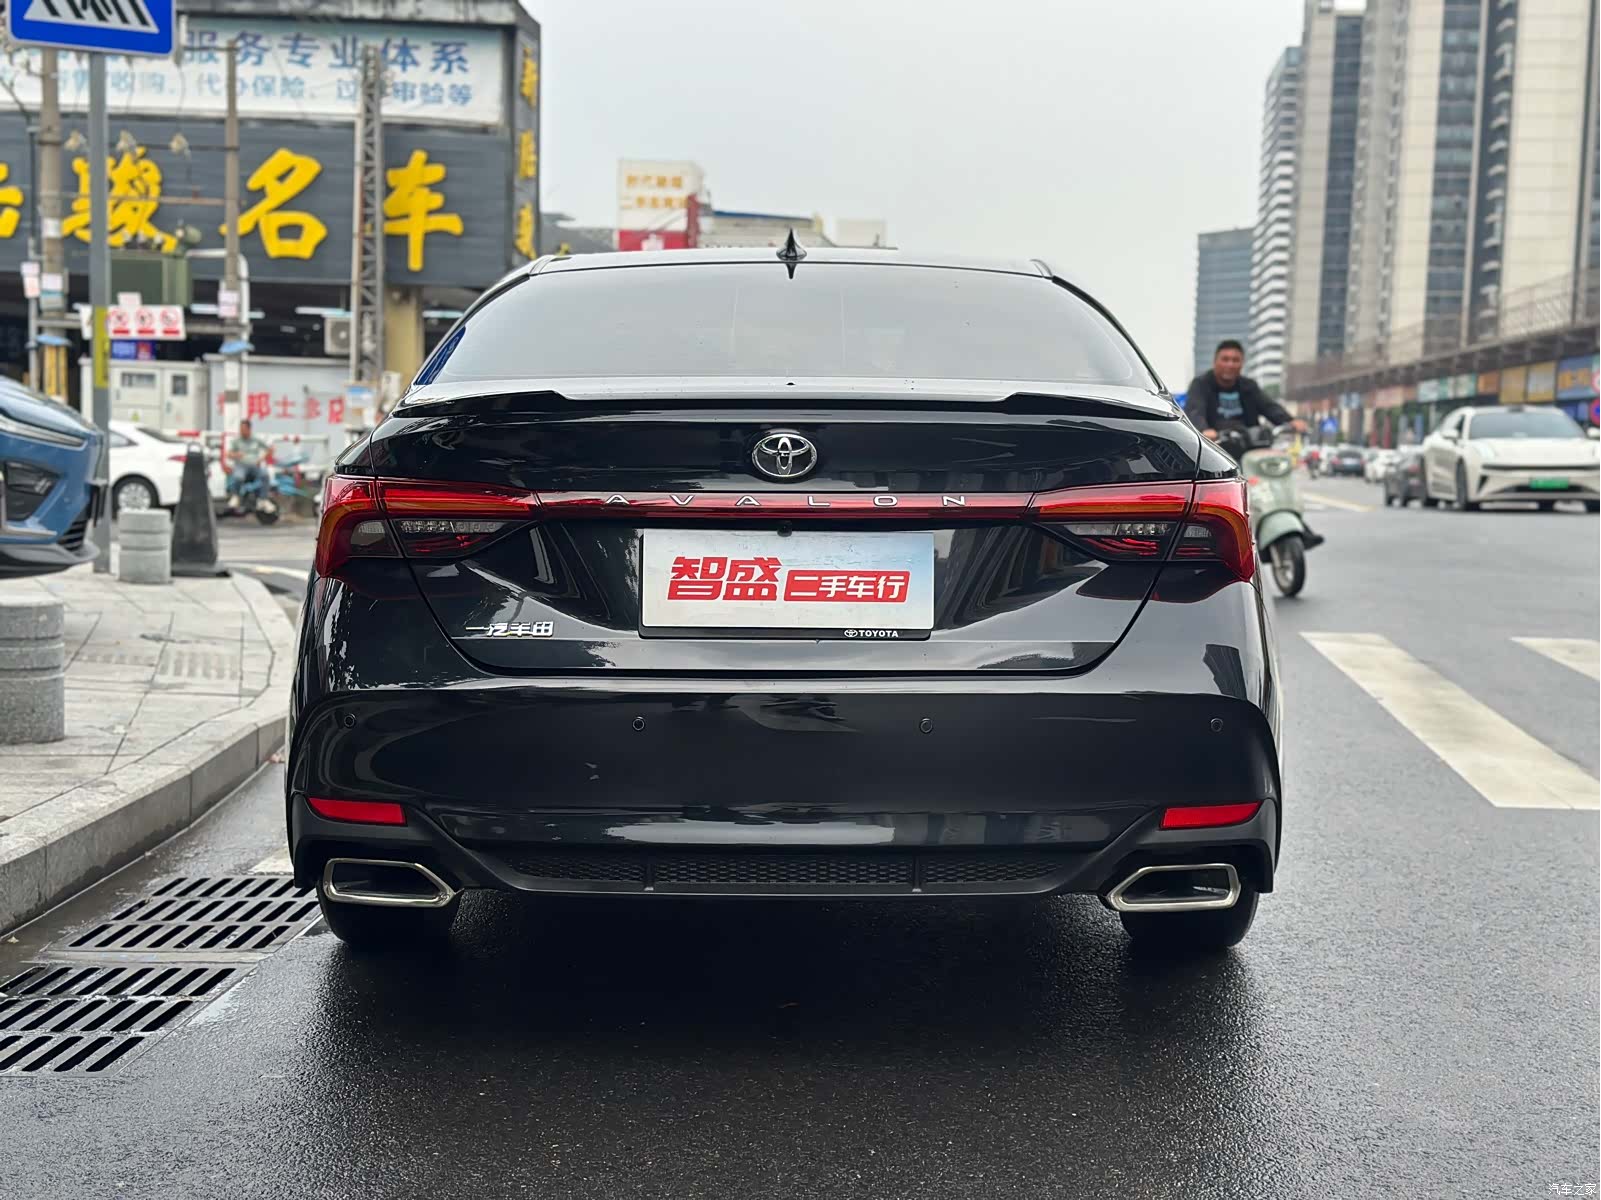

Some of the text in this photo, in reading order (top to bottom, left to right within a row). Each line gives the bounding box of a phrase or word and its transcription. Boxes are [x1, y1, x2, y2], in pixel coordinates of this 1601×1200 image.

[604, 494, 966, 506] AVALON
[667, 556, 906, 601] 智盛 二手车行
[465, 622, 554, 637] 一汽丰田
[858, 630, 899, 638] TOYOTA
